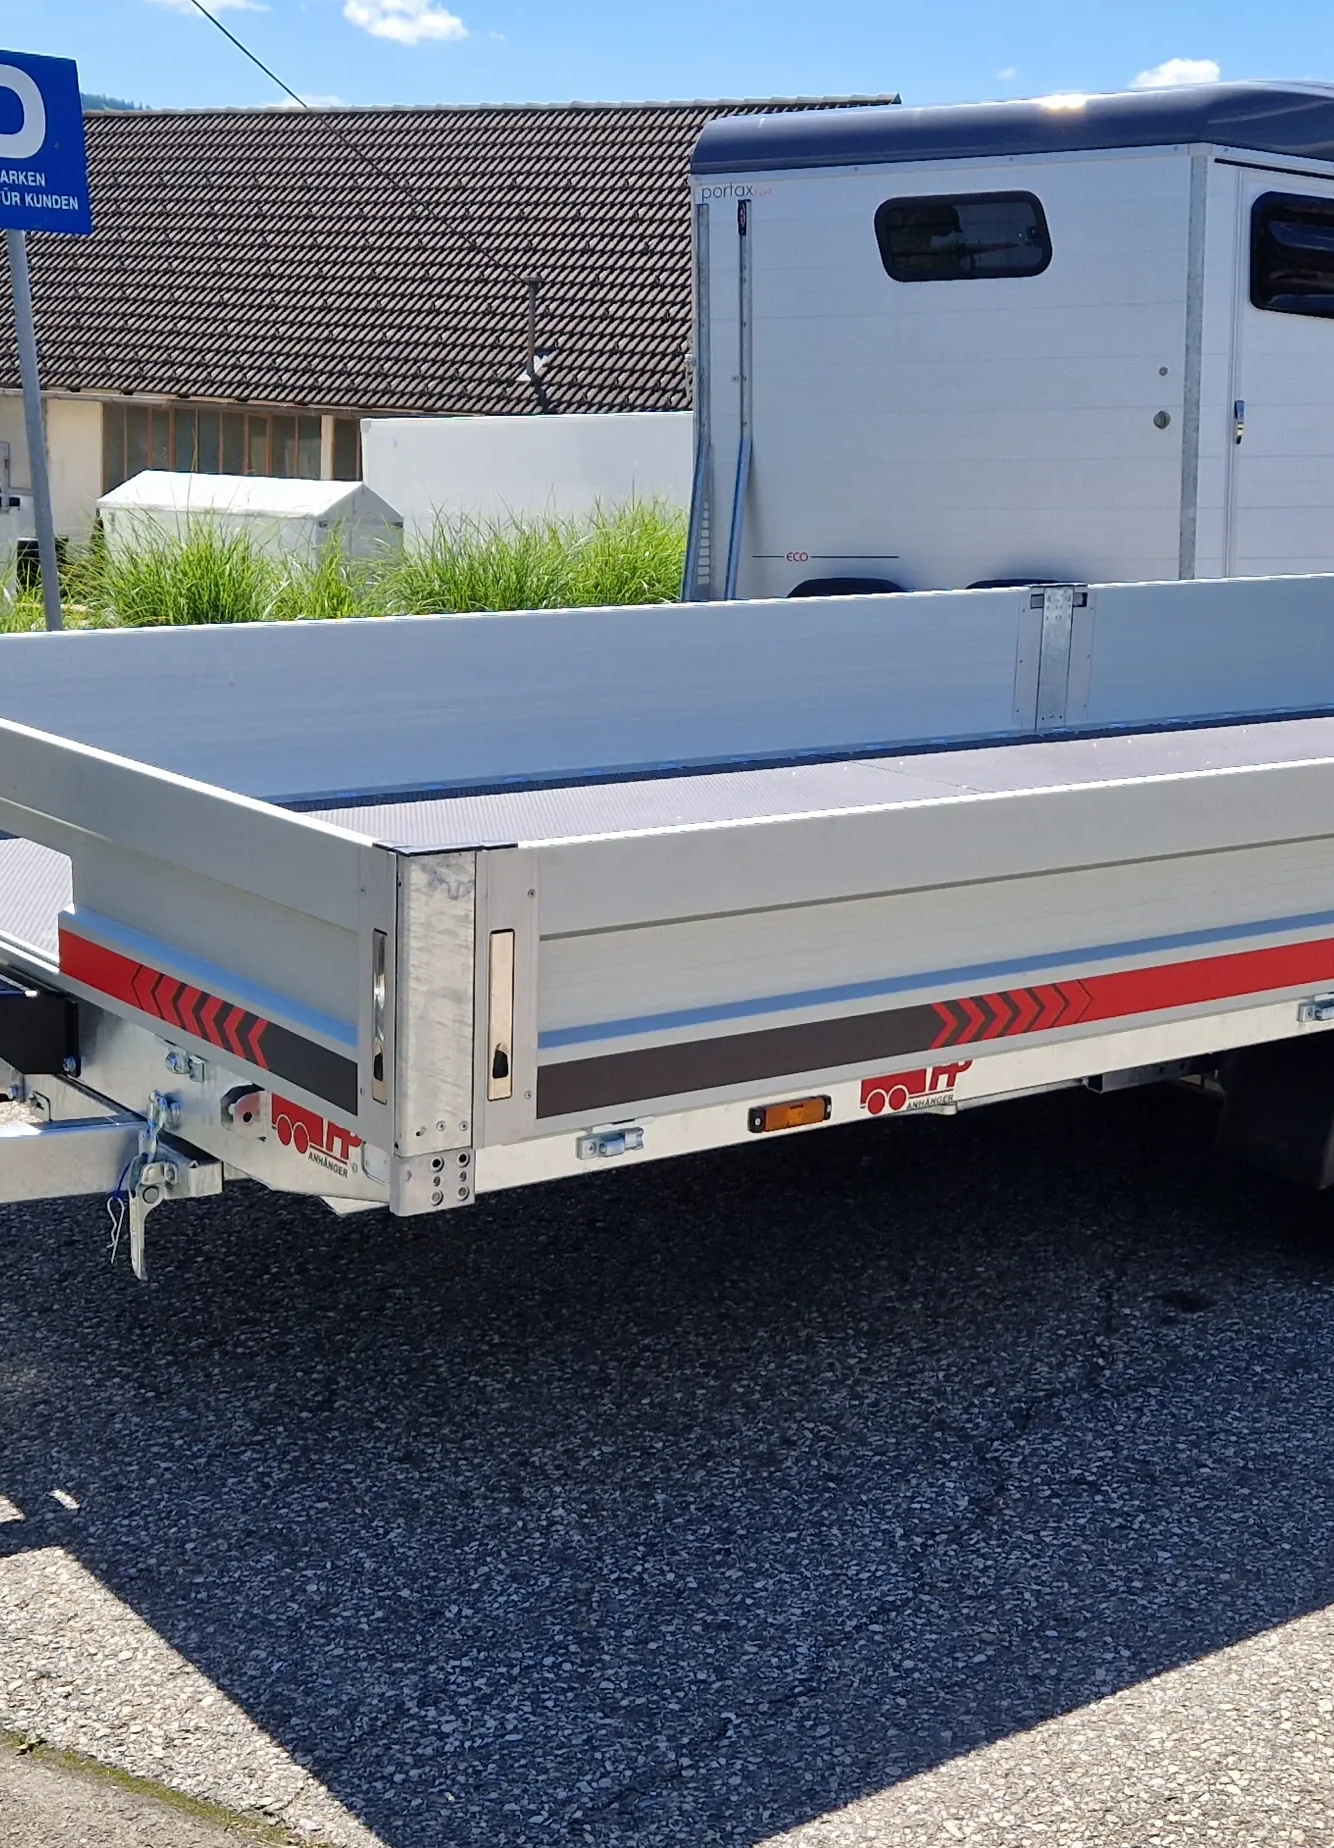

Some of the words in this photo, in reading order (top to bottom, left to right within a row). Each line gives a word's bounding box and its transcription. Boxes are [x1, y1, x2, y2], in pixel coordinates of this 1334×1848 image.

[24, 193, 79, 211] KUNDEN
[786, 551, 809, 562] ECO
[907, 1094, 955, 1111] ANHÄNGER
[308, 1151, 348, 1179] ANHÄNGER
